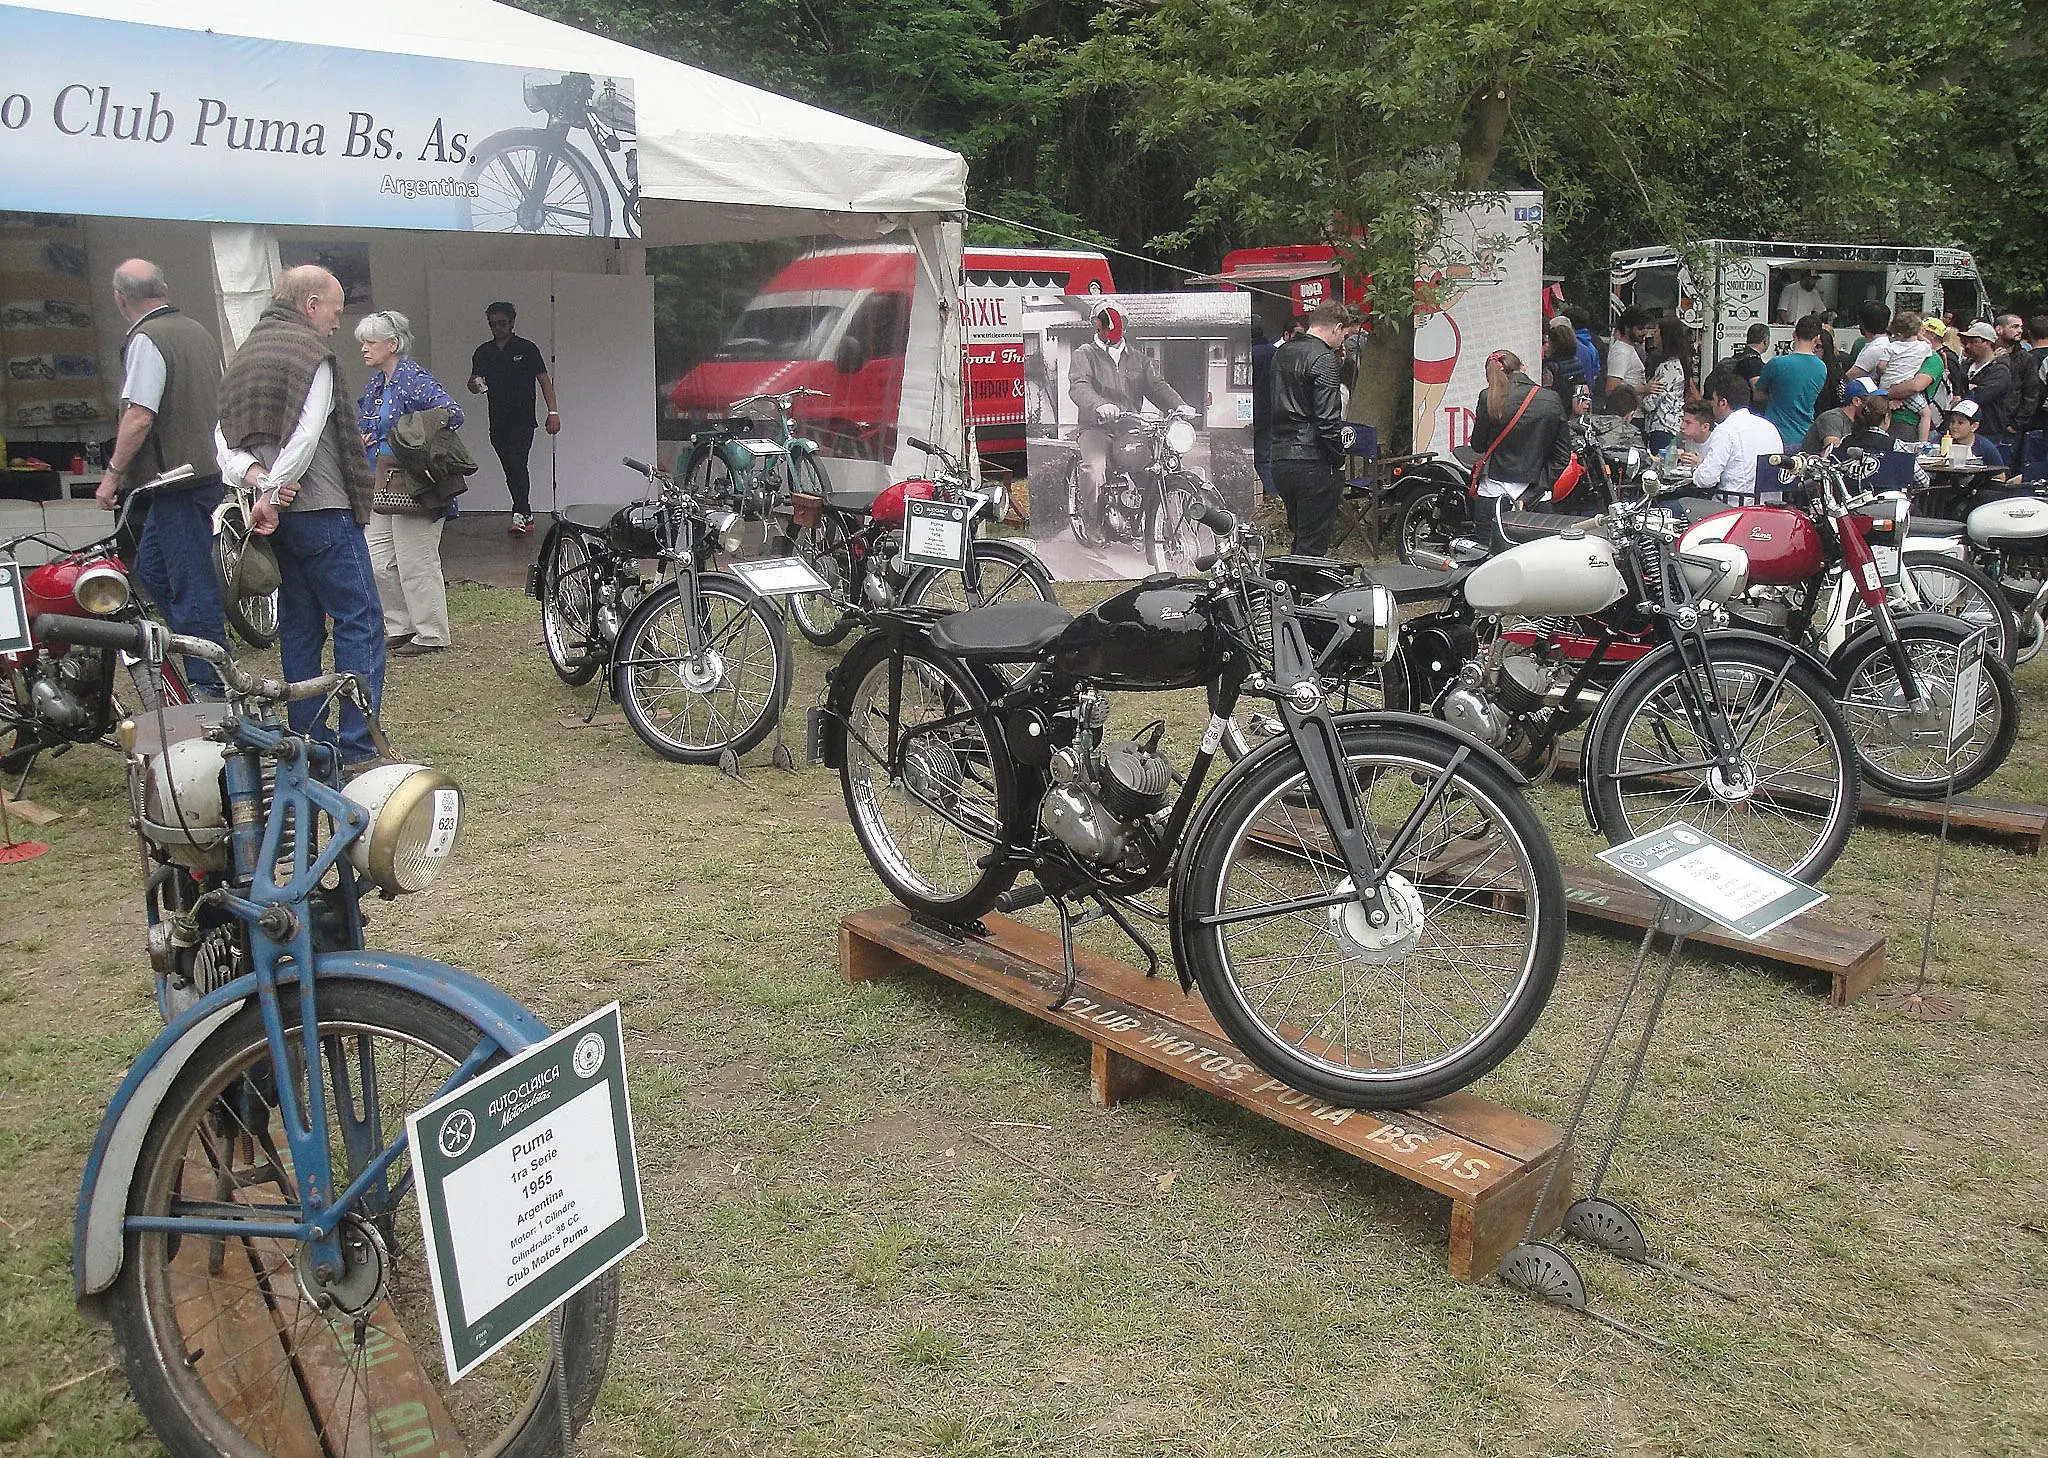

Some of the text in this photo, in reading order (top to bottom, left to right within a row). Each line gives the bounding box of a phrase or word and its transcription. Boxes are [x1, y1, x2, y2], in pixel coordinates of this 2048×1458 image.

[53, 84, 175, 144] Club
[190, 98, 327, 156] Puma
[341, 111, 403, 161] Bs.
[417, 117, 478, 165] As.
[380, 174, 480, 200] Argentina
[1726, 280, 1763, 291] SMOKE TRUCK
[1750, 526, 1772, 541] Puma
[438, 817, 455, 831] 623
[1060, 997, 1141, 1033] CLUB
[1138, 1031, 1255, 1080] MOTOS
[1365, 1124, 1429, 1153] BS
[1424, 1150, 1491, 1180] AS
[511, 1128, 554, 1163] Puma
[511, 1148, 558, 1184] 1ra Serie
[522, 1170, 553, 1200] 1955
[510, 1226, 537, 1249] Motor:
[544, 1200, 576, 1225] Cilindro
[516, 1188, 564, 1226] Argentina
[506, 1225, 589, 1287] Club Motos Puma
[511, 1231, 555, 1266] Cilindrada:
[567, 1213, 580, 1227] CC
